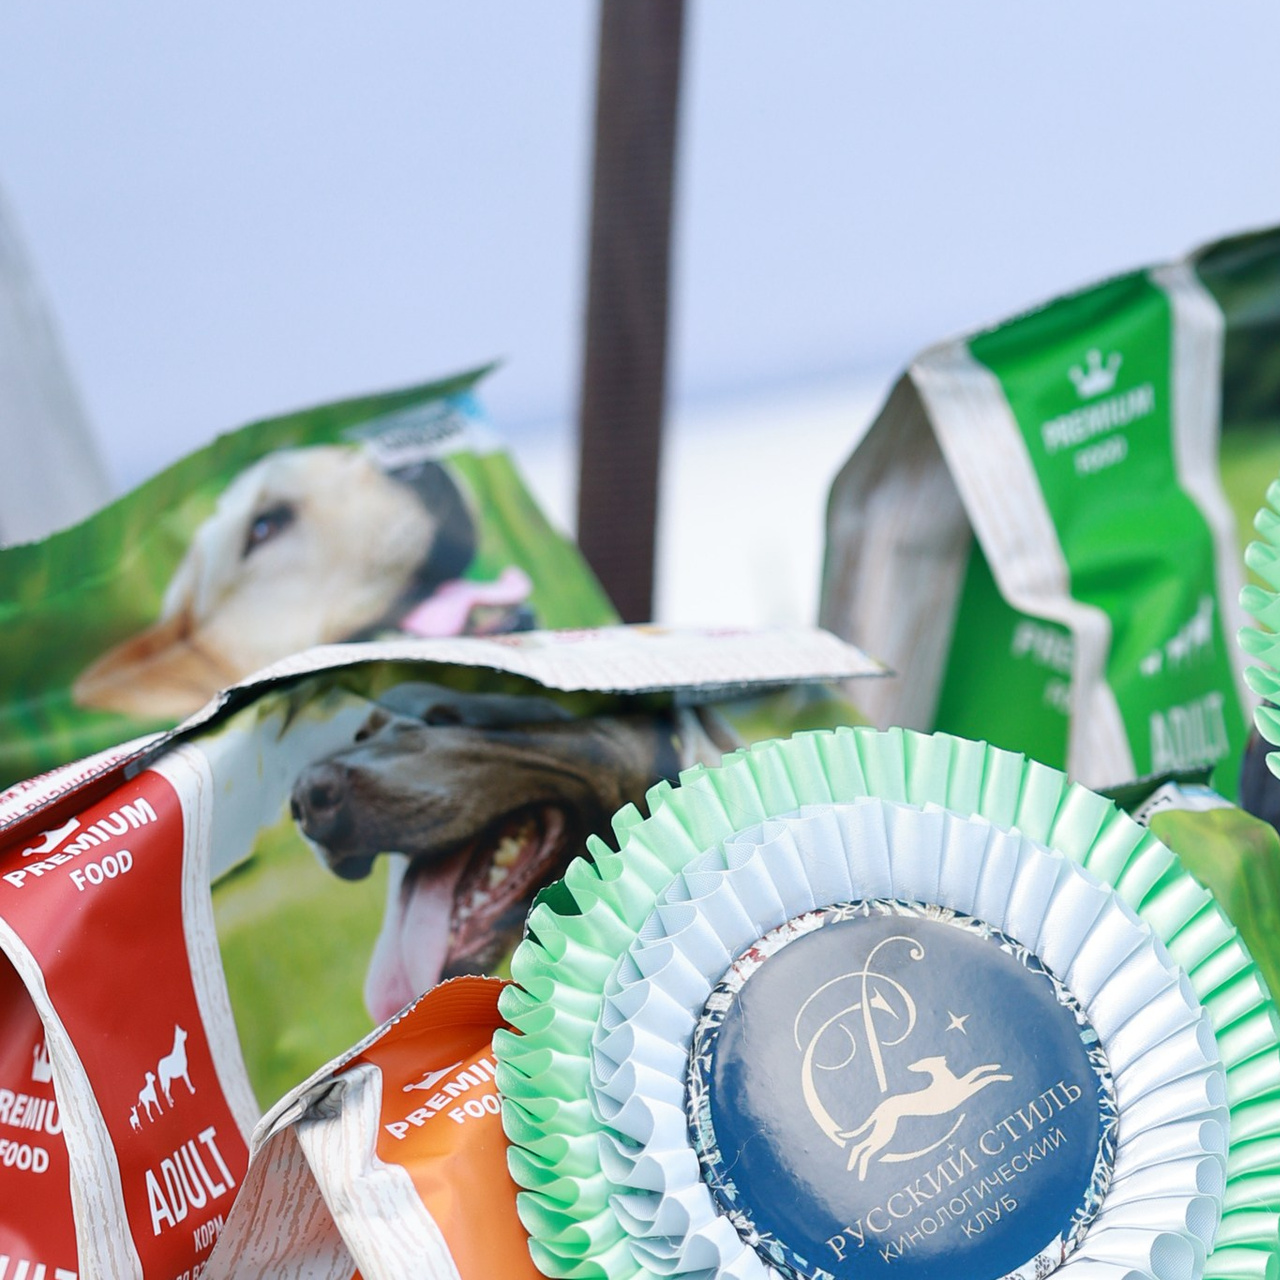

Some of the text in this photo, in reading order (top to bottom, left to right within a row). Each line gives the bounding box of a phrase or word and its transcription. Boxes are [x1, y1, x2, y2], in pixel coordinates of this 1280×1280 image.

[2, 797, 158, 888] PREMIUM
[68, 849, 134, 892] FOOD
[0, 1088, 63, 1136] REMIU
[446, 1093, 505, 1125] FOO
[144, 1126, 236, 1237] ADULT
[824, 1080, 1084, 1262] РУССКИЙ СТИЛЬ
[878, 1126, 1067, 1264] КИНОЛОГИЧЕСКИЙ
[960, 1195, 1020, 1240] КЛУБ
